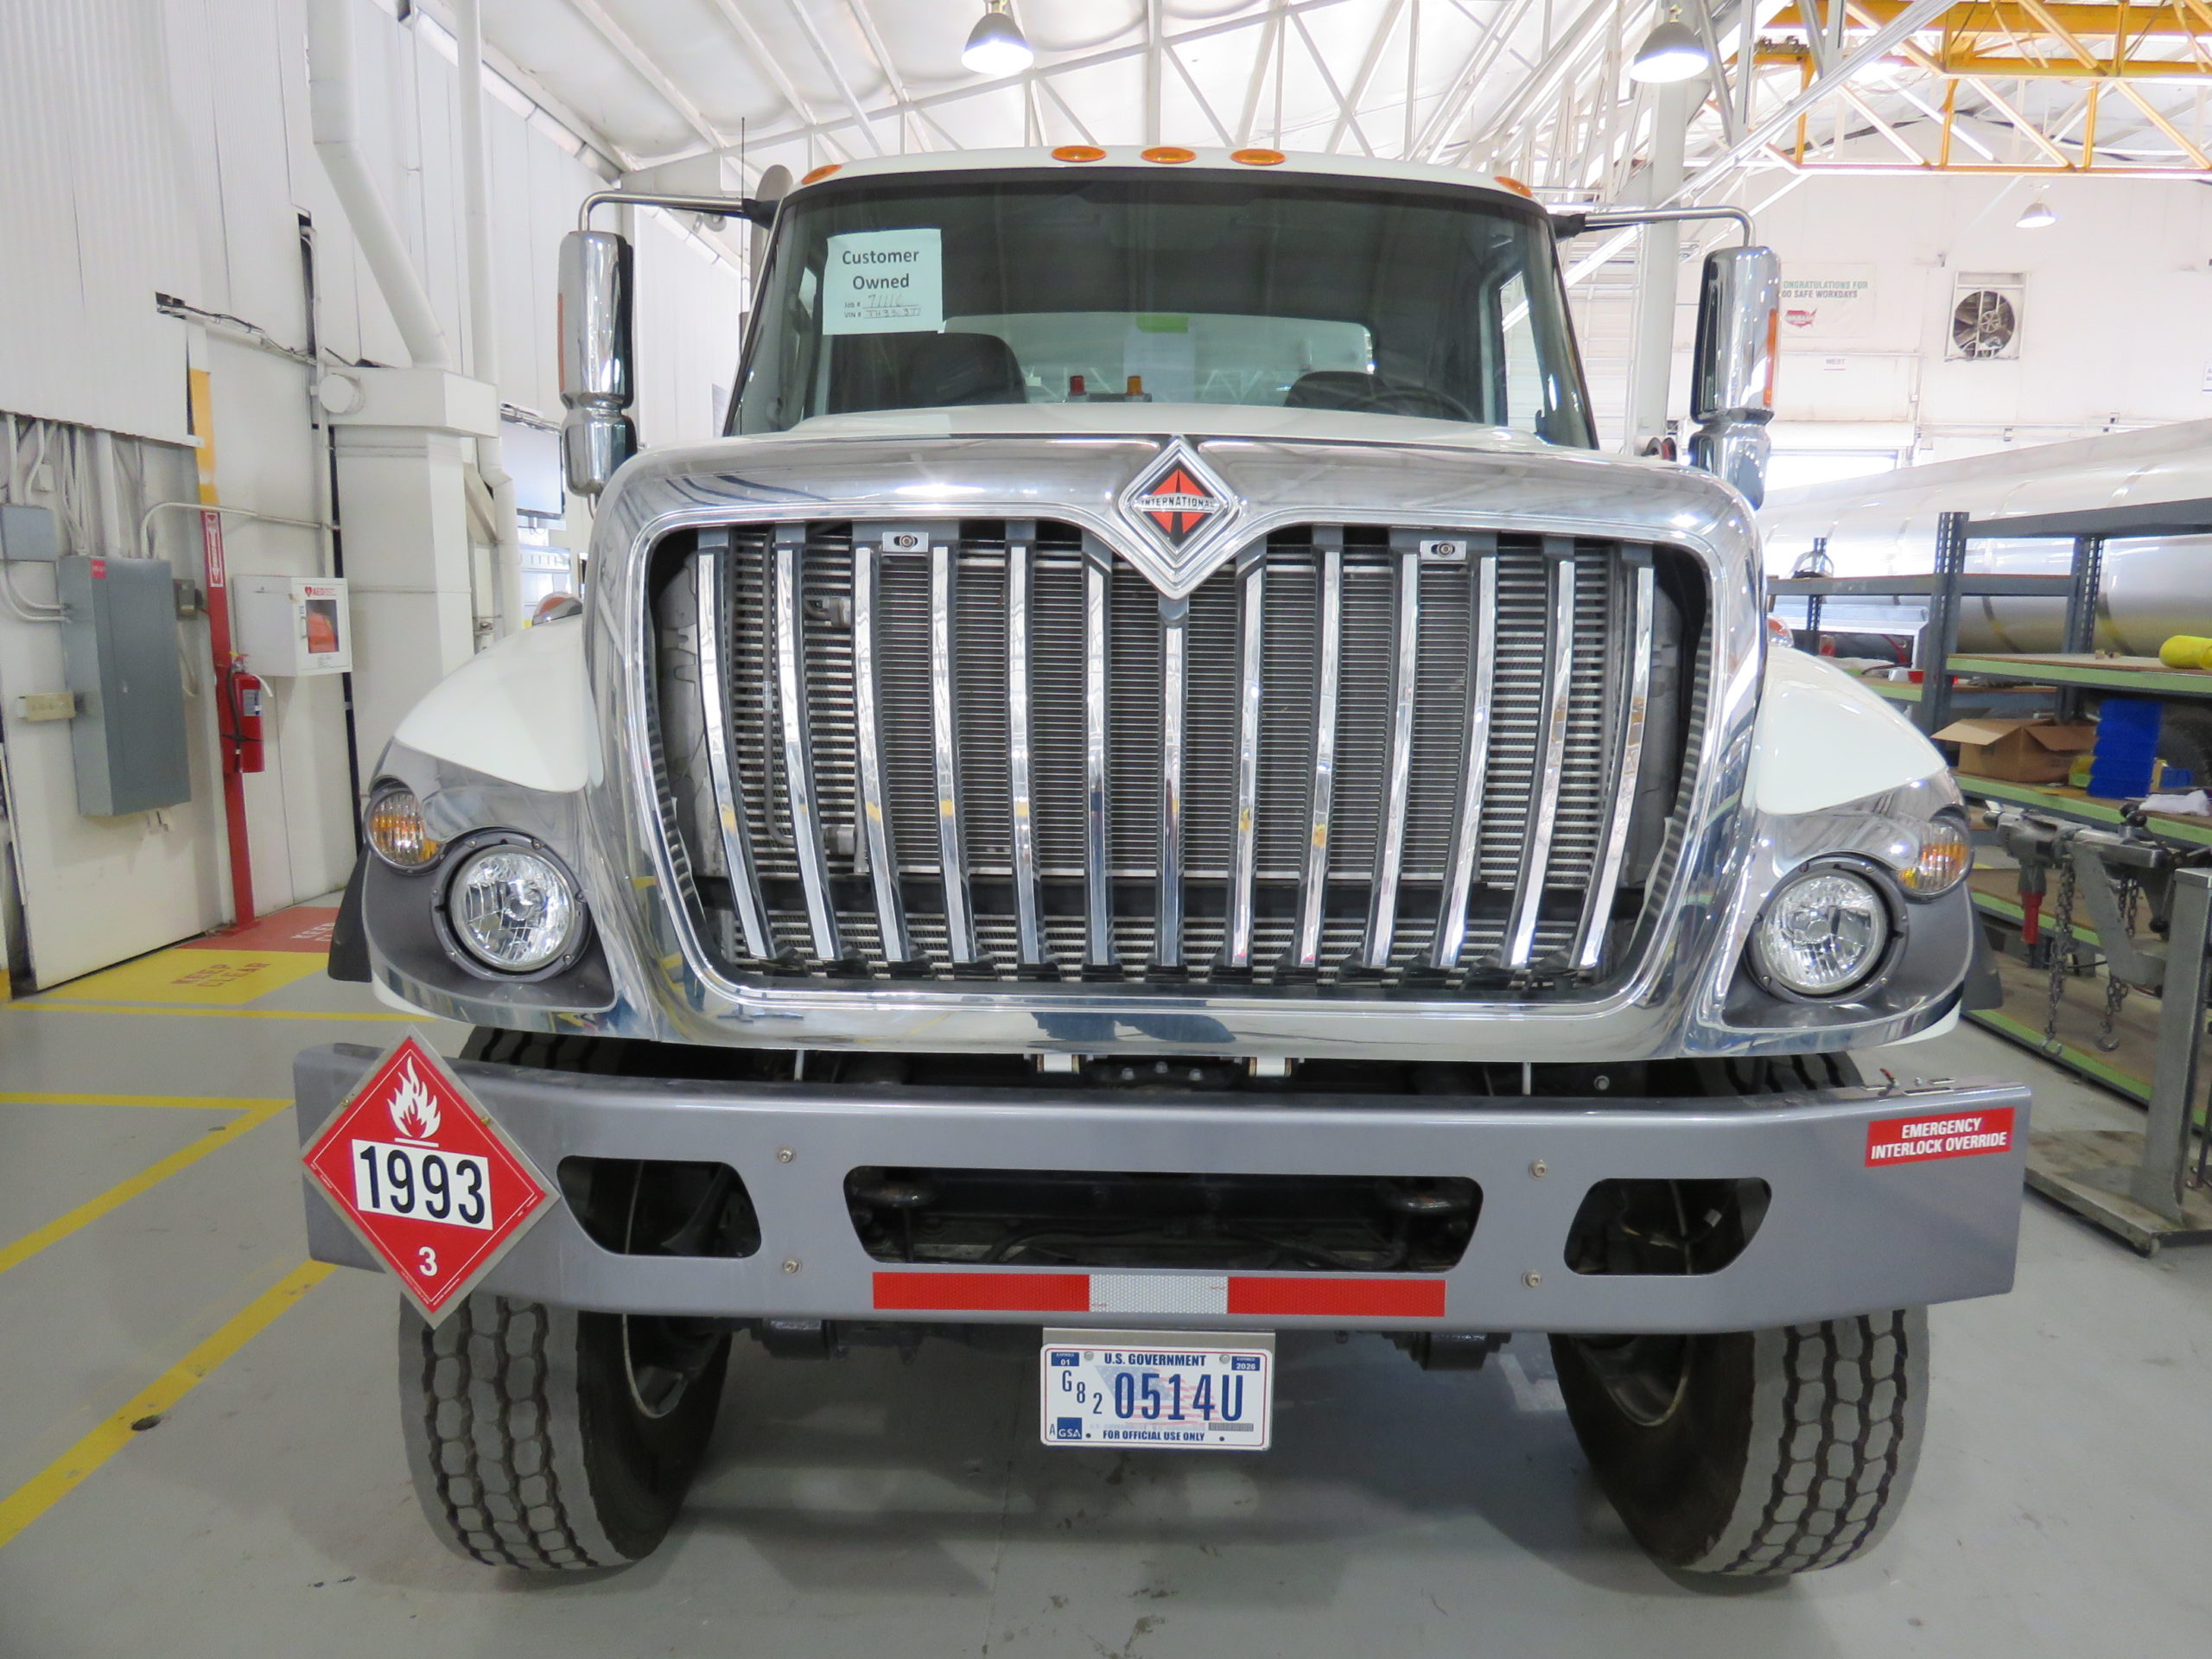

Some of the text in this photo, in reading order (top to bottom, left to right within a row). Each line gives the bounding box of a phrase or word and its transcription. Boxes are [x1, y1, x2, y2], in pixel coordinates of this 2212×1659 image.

[842, 251, 919, 264] Customer
[853, 273, 909, 289] Owned
[1783, 281, 1868, 289] ONGRATULATIONS FOR
[1815, 290, 1858, 299] WORKDAYS
[1141, 496, 1215, 508] INTERNATIONAL
[171, 963, 231, 985] KEEP
[197, 963, 270, 988] CLEAR
[1901, 1117, 1982, 1139] EMERGENCY
[1871, 1131, 2007, 1160] INTERLOCK OVERRIDE
[359, 1146, 486, 1224] 1993
[418, 1246, 439, 1277] 3
[1104, 1352, 1206, 1366] U.S. GOVERNMENT
[1115, 1372, 1243, 1421] 0514U
[1058, 1428, 1081, 1438] GSA
[1103, 1430, 1205, 1441] FOR OFFICIAL USE ONLY
